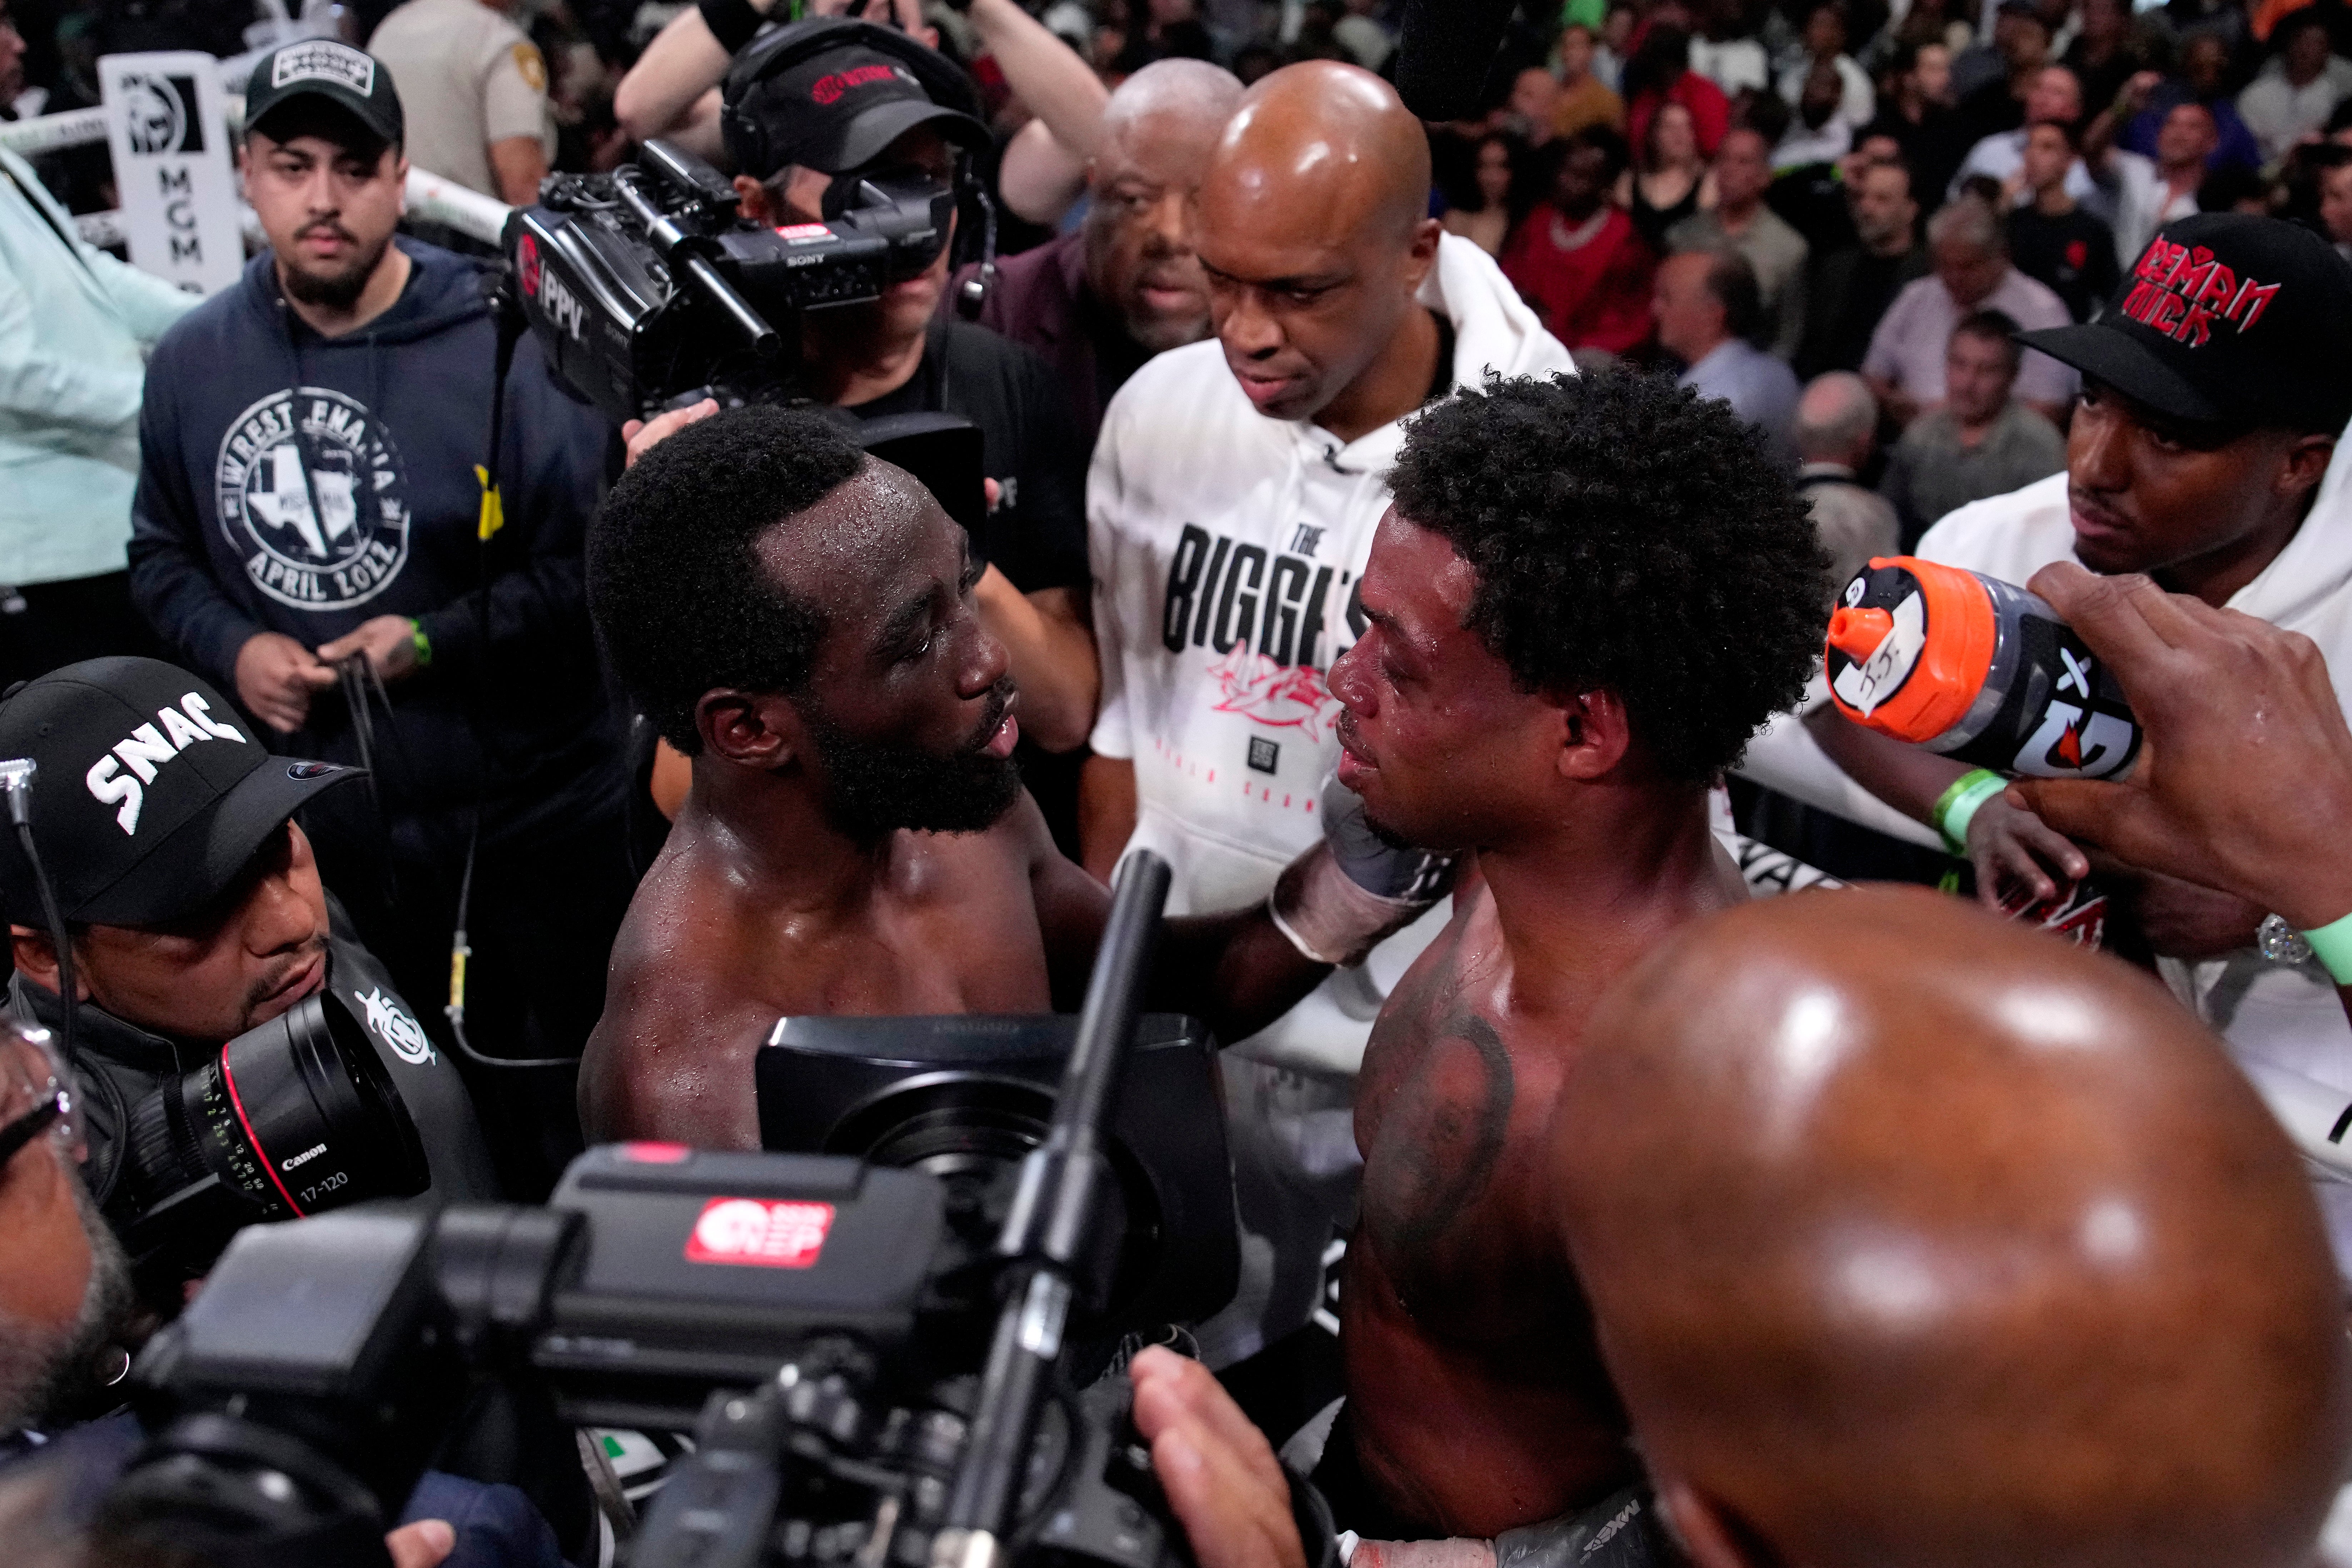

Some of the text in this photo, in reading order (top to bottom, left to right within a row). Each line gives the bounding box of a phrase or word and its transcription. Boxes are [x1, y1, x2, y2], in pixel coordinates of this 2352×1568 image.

[787, 253, 825, 267] SONY
[543, 267, 583, 341] PPV
[1289, 522, 1326, 557] THE
[247, 552, 327, 601] APRIL
[86, 692, 247, 836] SNAC
[282, 1143, 327, 1171] Canon
[244, 1162, 255, 1174] 20
[253, 1178, 264, 1190] 50
[300, 1172, 348, 1203] 17-120
